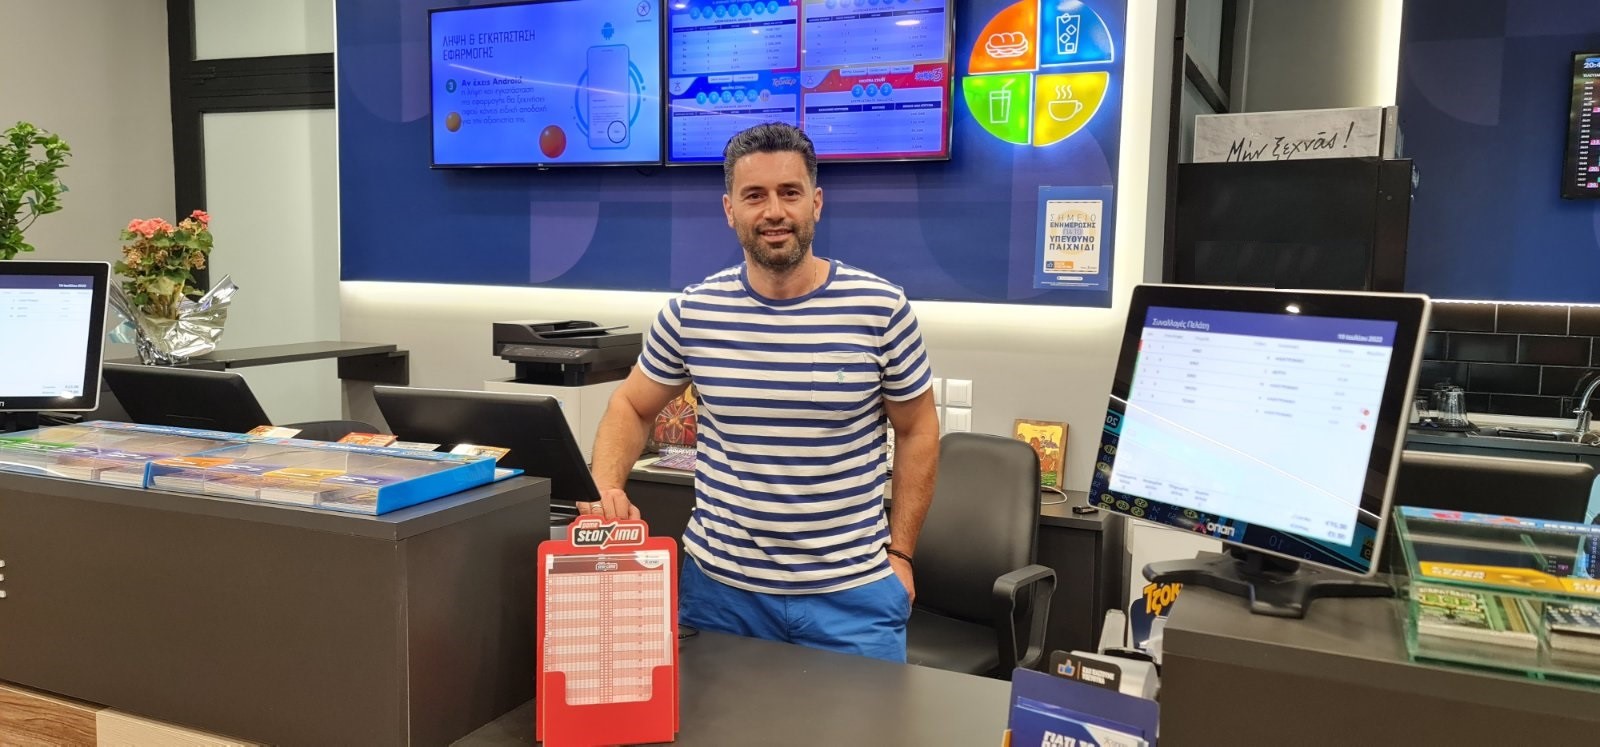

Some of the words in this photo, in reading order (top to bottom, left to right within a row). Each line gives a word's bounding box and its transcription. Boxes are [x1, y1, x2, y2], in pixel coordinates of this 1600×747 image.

[443, 35, 466, 46] ΛΗΨΗ
[479, 30, 535, 44] ΕΓΚΑΤΑΣΤΑΣΗ
[443, 47, 494, 60] ΕΦΑΡΜΟΓΗΣ
